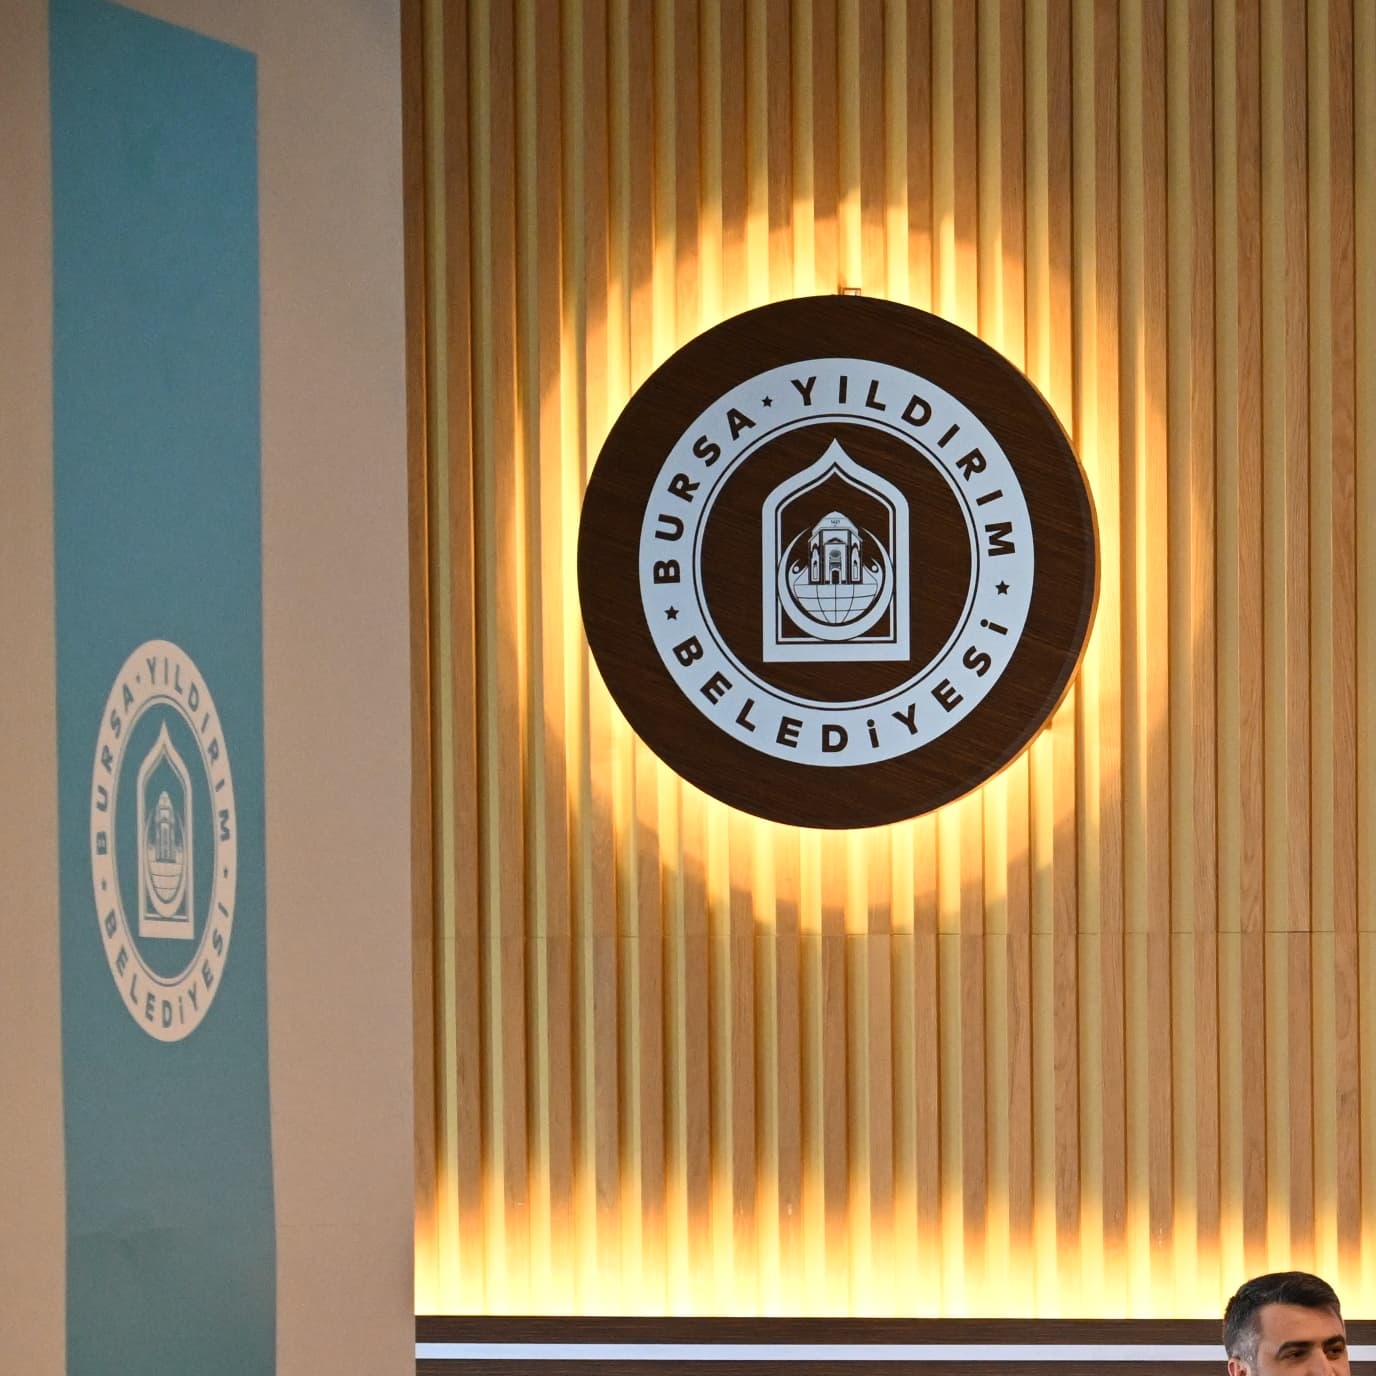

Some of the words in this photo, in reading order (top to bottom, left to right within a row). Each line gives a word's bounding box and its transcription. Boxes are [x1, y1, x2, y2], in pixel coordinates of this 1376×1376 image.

[652, 406, 757, 585] BURSA
[789, 375, 1016, 558] YILDIRIM
[95, 685, 134, 856] BURSA
[146, 656, 231, 842] YILDIRIM
